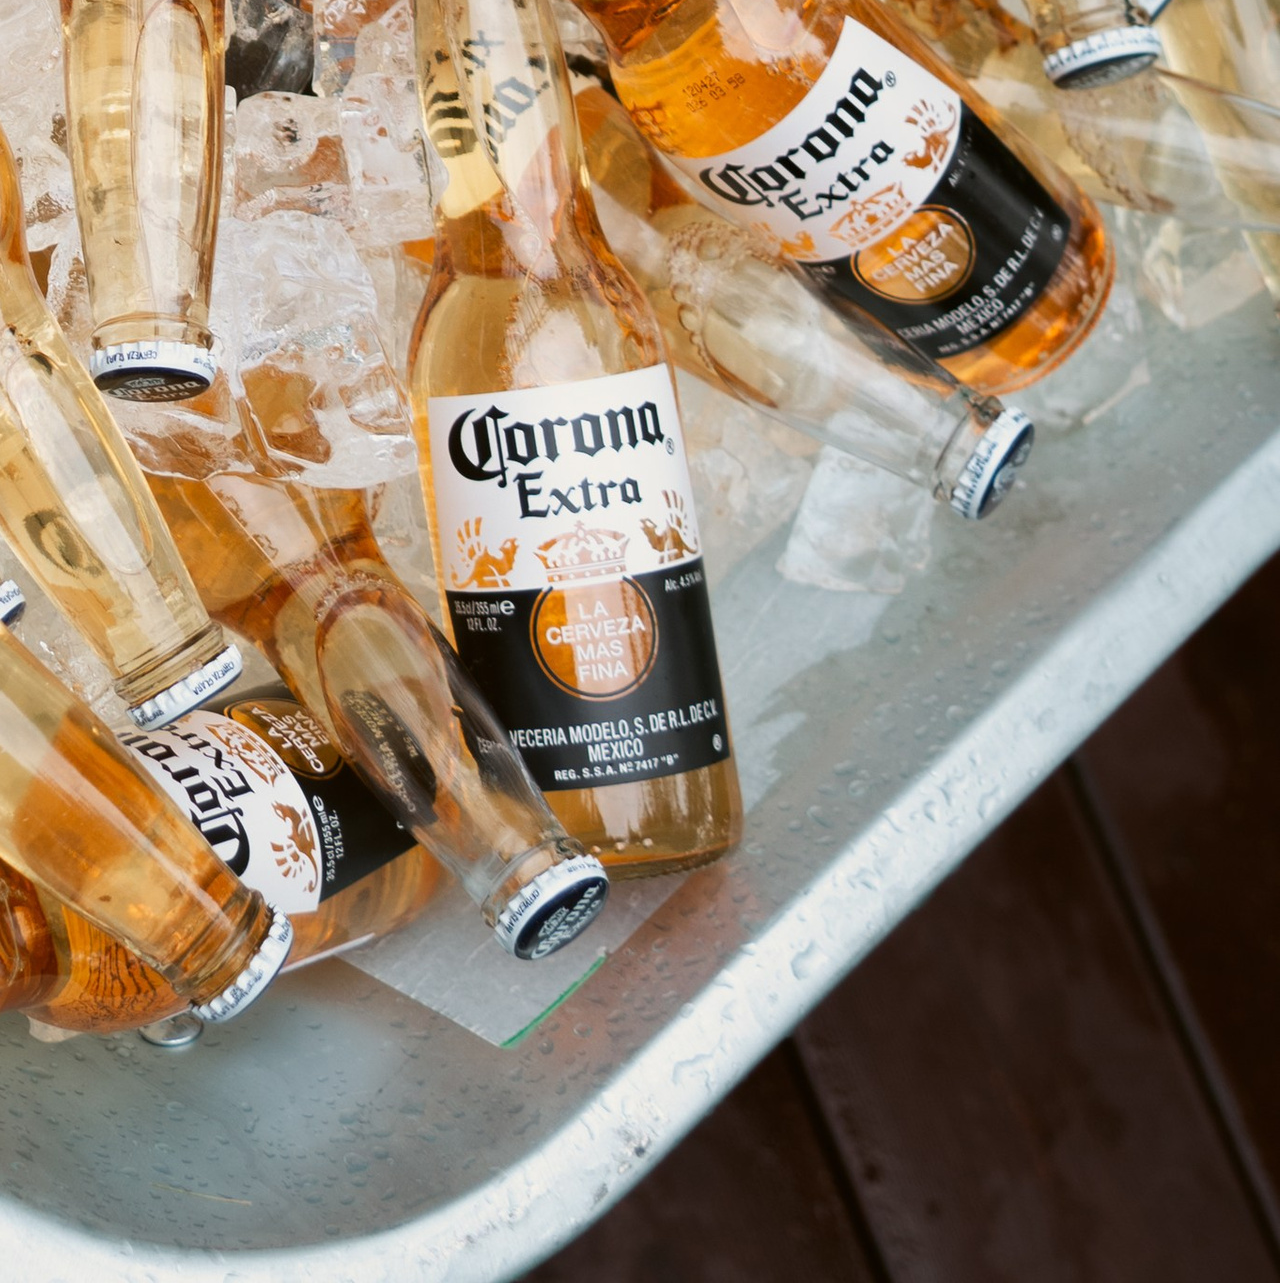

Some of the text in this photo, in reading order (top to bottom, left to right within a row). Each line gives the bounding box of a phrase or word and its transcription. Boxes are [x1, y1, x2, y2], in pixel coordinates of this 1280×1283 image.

[681, 69, 724, 102] 120427
[699, 69, 883, 207] Corona
[778, 141, 894, 221] Extra
[872, 222, 954, 280] CERVEZA
[888, 237, 916, 257] LA
[904, 250, 946, 281] MAS
[915, 262, 959, 292] FINA
[955, 297, 1004, 334] MEXICO
[448, 402, 664, 488] Corona
[513, 471, 642, 519] Extra
[578, 601, 608, 620] LA
[546, 615, 646, 645] CERVEZA
[576, 640, 623, 663] MAS
[578, 661, 628, 684] FINA
[268, 727, 292, 748] LA
[283, 715, 320, 747] MAS
[568, 703, 704, 744] MODELO, S. DE R.L. DE
[252, 707, 324, 773] CERVEZA
[587, 737, 644, 763] MEXICO
[554, 757, 659, 781] REG. S.S.A. 7417
